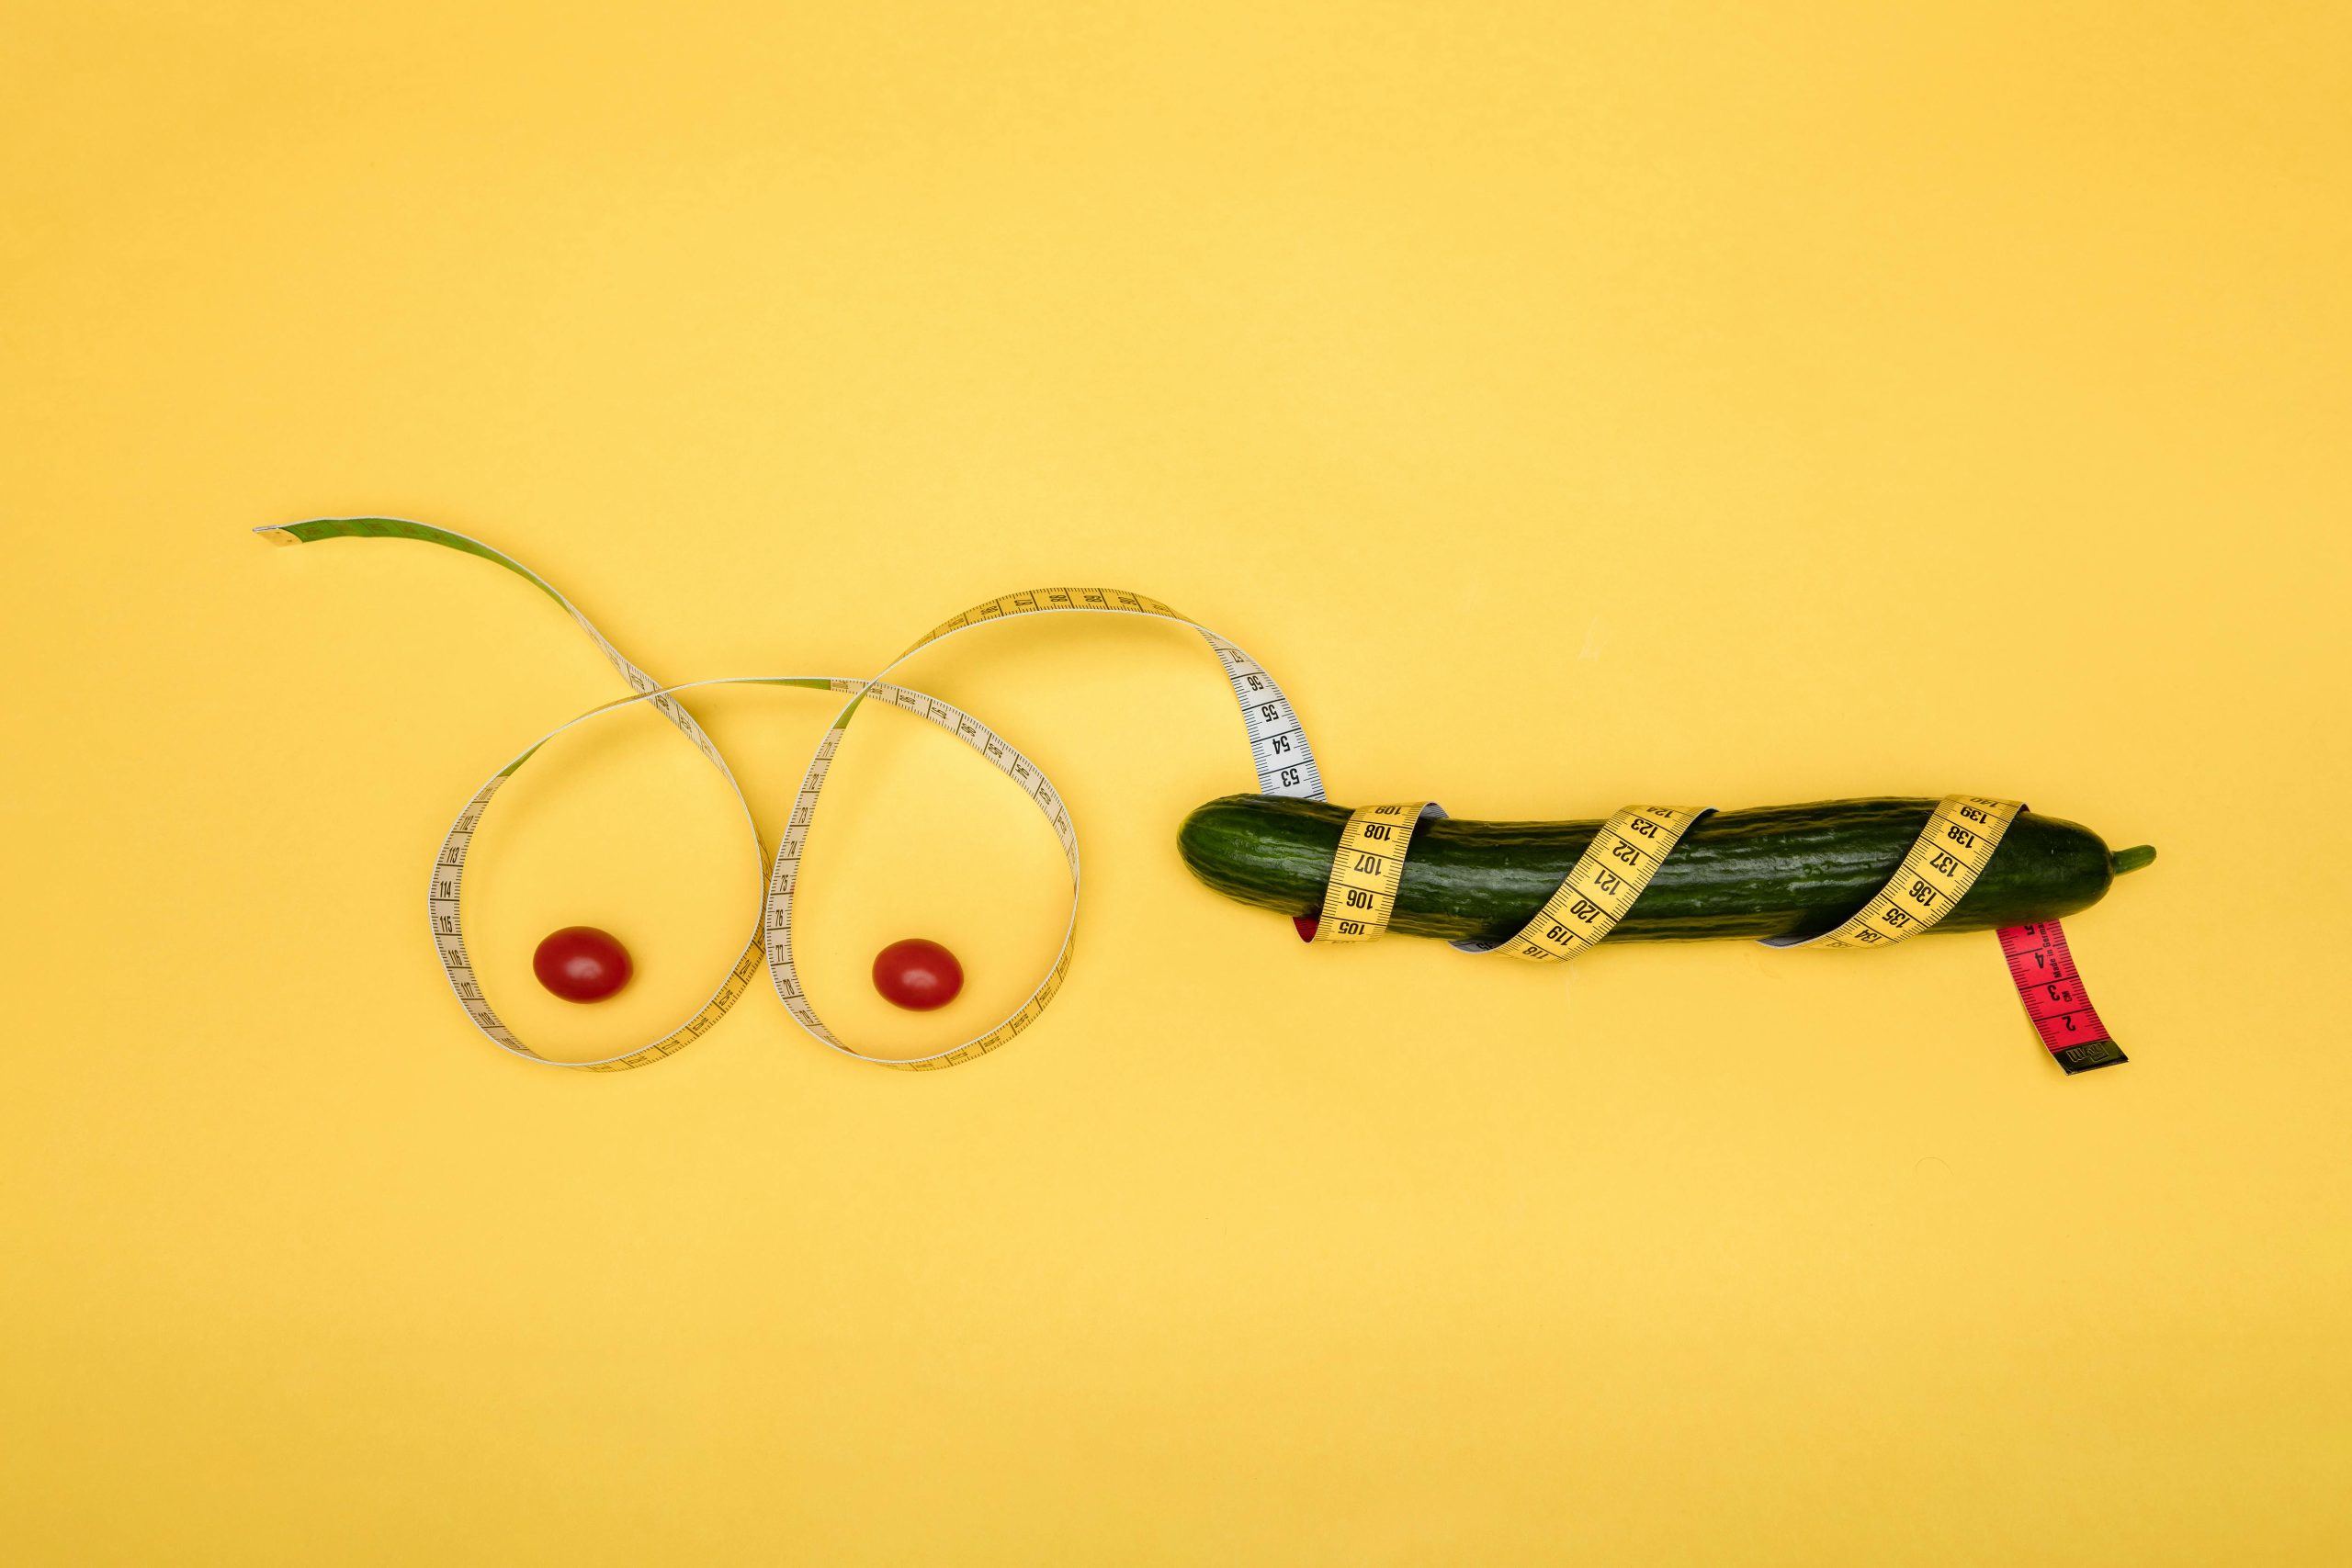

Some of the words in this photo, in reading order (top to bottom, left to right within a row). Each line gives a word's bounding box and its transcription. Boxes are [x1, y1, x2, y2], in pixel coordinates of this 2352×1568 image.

[1014, 599, 1034, 607] 87
[1049, 594, 1069, 603] 88
[1083, 594, 1103, 603] 89
[1117, 596, 1137, 606] 90
[1247, 675, 1263, 692] 56
[931, 706, 947, 719] 97
[1261, 704, 1279, 723] 55
[960, 723, 977, 738] 96
[988, 743, 1003, 759] 95
[1272, 735, 1291, 755] 54
[1015, 763, 1030, 780] 94
[1281, 768, 1300, 787] 53
[808, 773, 820, 790] 72
[1039, 787, 1052, 806] 93
[1970, 796, 1999, 808] 140
[798, 807, 808, 824] 73
[1374, 807, 1402, 816] 109
[1646, 807, 1674, 818] 124
[1960, 807, 1988, 824] 139
[460, 815, 474, 830] 112
[1631, 818, 1659, 839] 123
[1363, 824, 1392, 841] 108
[1947, 825, 1975, 849] 138
[447, 847, 460, 863] 113
[788, 840, 797, 857] 74
[1612, 840, 1640, 866] 122
[1353, 854, 1383, 876] 107
[1929, 852, 1960, 878] 137
[440, 881, 452, 897] 114
[779, 874, 788, 892] 75
[1594, 869, 1621, 896] 121
[1346, 889, 1374, 910] 106
[1908, 880, 1938, 907] 136
[775, 909, 784, 927] 76
[1570, 899, 1600, 924] 120
[1882, 908, 1911, 929] 135
[440, 916, 453, 933] 115
[1338, 921, 1365, 935] 105
[2023, 925, 2035, 936] 5
[1546, 925, 1574, 946] 119
[1854, 929, 1883, 943] 134
[2038, 923, 2051, 948] Germa
[448, 949, 463, 965] 116
[775, 944, 784, 962] 77
[1522, 946, 1550, 960] 118
[2034, 953, 2044, 969] 4
[2046, 949, 2054, 957] in
[2050, 958, 2063, 978] Made
[460, 982, 475, 998] 117
[783, 978, 795, 996] 78
[2047, 985, 2061, 1001] 3
[478, 1012, 496, 1026] 118
[2062, 1015, 2076, 1032] 2
